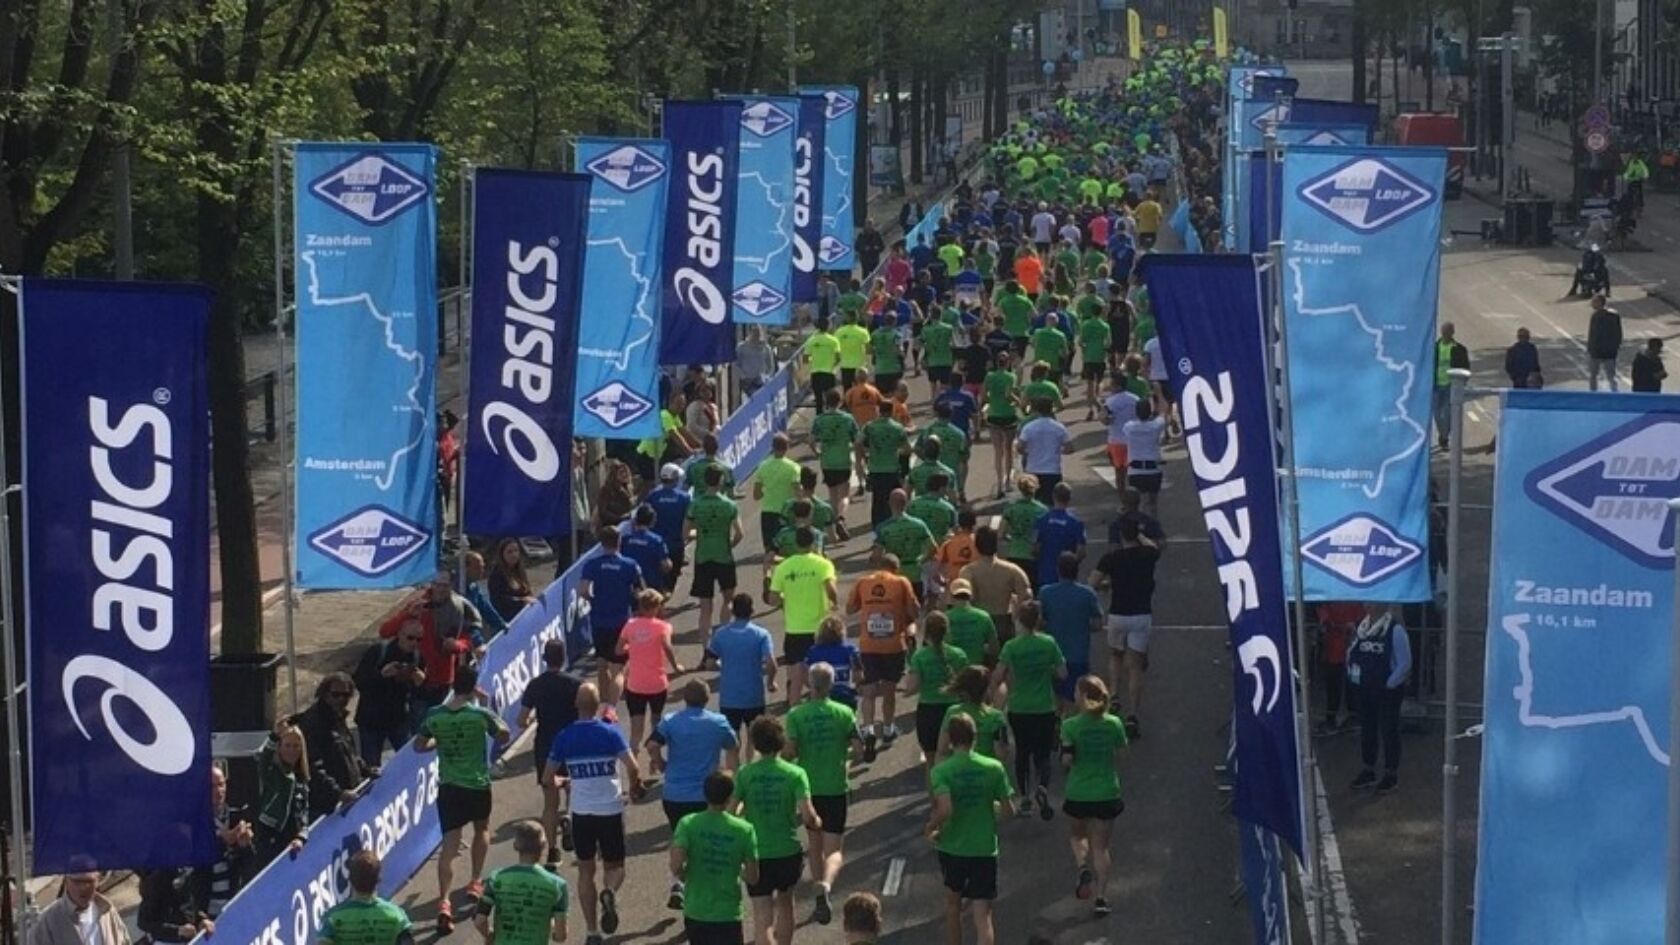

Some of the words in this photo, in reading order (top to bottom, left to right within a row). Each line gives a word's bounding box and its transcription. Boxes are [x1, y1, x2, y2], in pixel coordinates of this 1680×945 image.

[306, 233, 372, 246] Zaandam
[1293, 240, 1362, 254] Zaandam
[304, 457, 386, 470] Amsterdam
[1607, 455, 1677, 478] DAM
[1594, 500, 1668, 521] DAM
[1514, 580, 1654, 608] Zaandam
[1573, 615, 1597, 628] km
[567, 761, 617, 779] ERIKS
